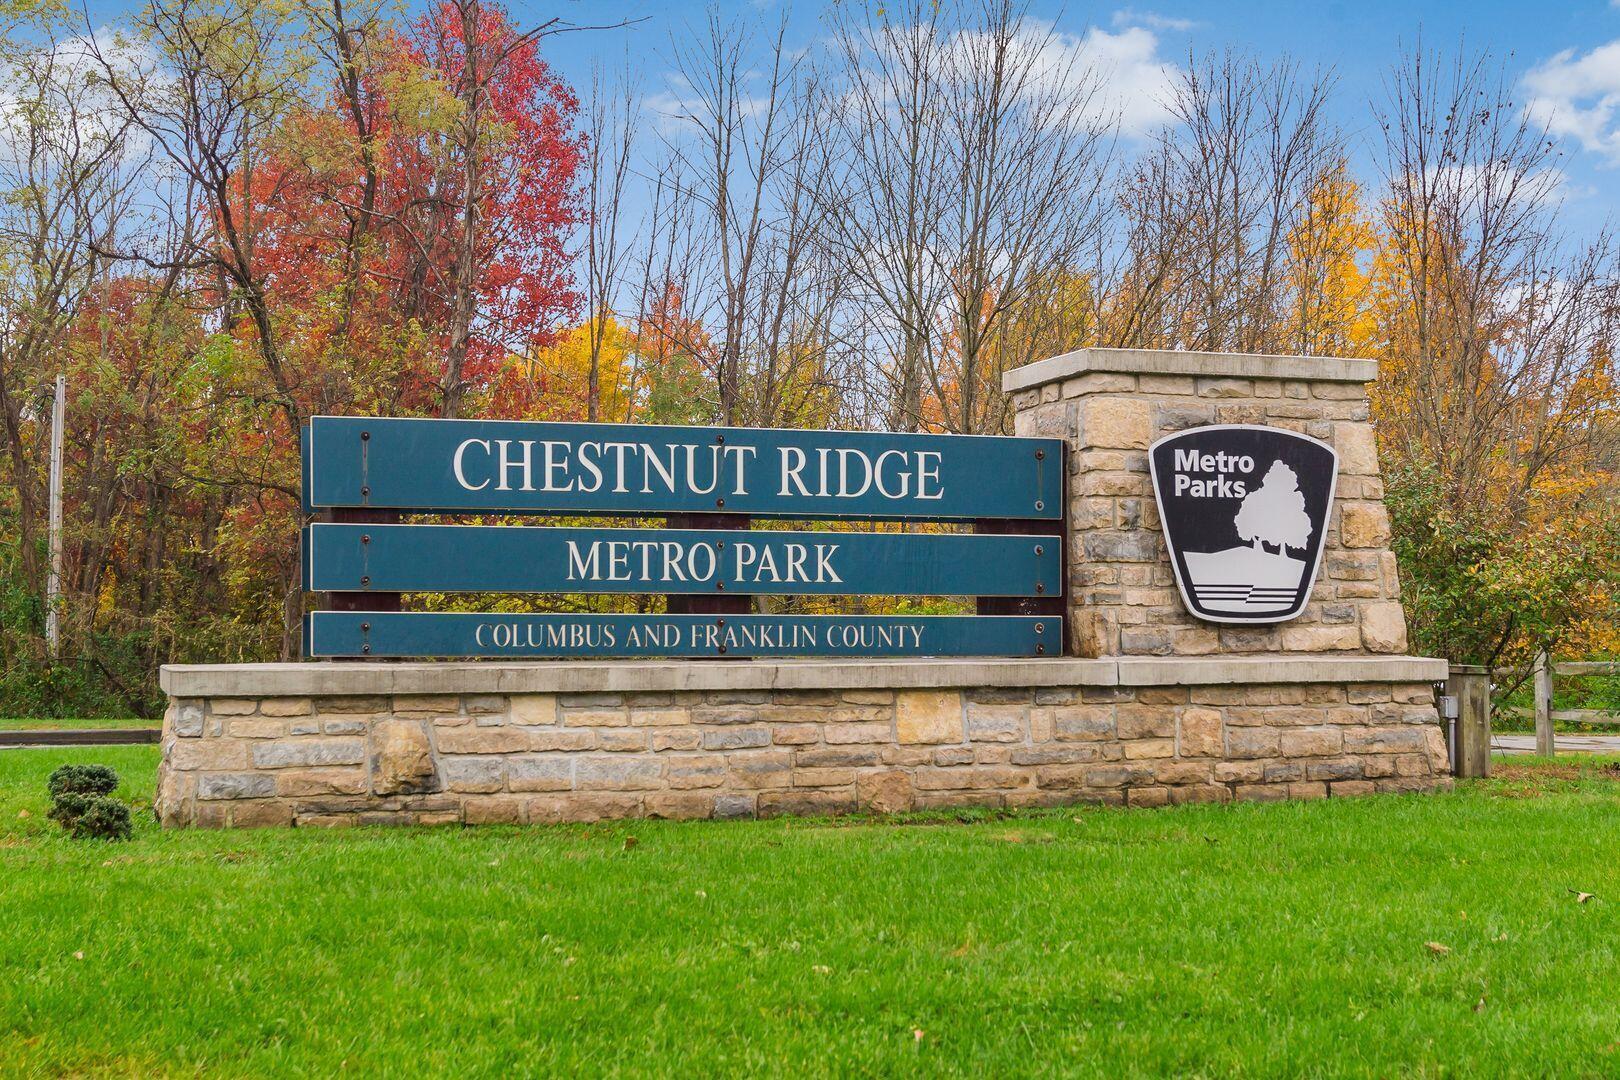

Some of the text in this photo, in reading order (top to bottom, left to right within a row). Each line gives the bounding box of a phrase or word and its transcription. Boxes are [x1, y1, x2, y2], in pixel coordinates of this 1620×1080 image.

[453, 437, 945, 500] CHESTNUT RIDGE
[1174, 448, 1255, 474] Metro
[1174, 473, 1247, 499] Parks
[566, 539, 844, 584] METRO PARK
[474, 622, 926, 649] COLUMBUS AND FRANKLIN COUNTY
